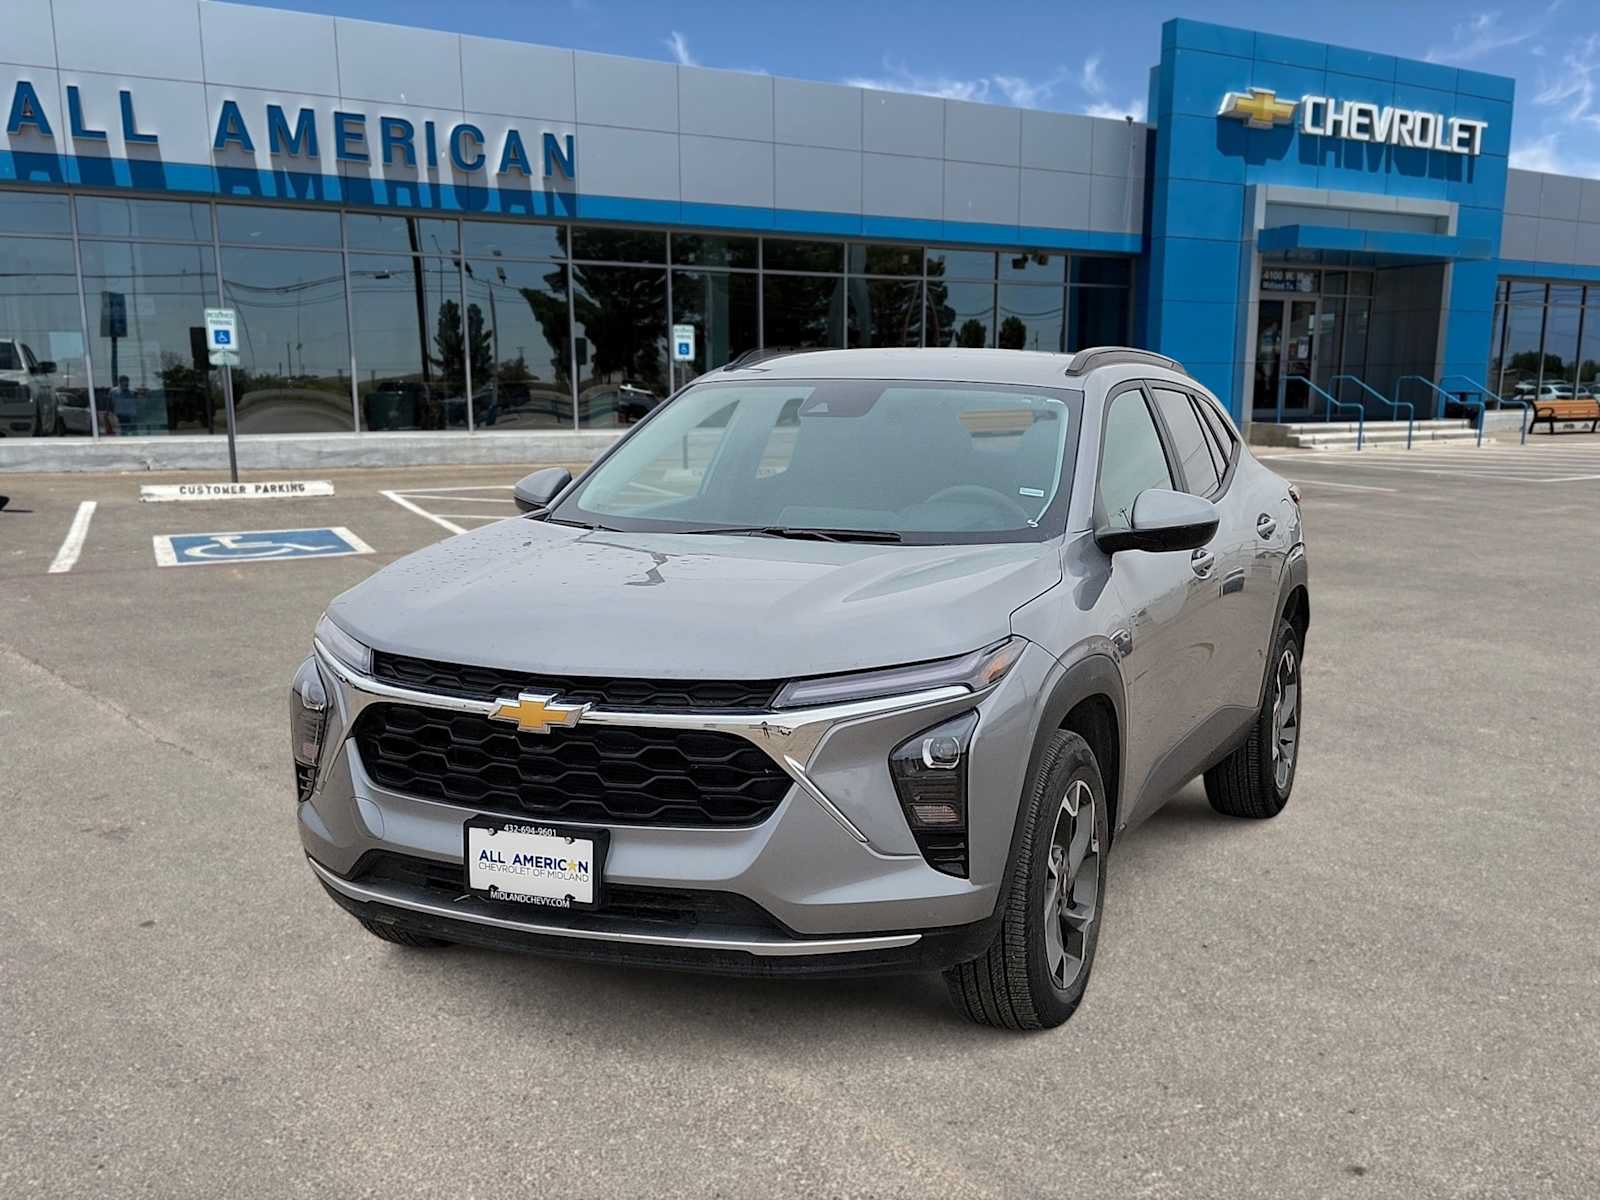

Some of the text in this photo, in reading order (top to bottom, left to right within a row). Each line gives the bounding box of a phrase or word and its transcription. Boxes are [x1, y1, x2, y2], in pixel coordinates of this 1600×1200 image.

[6, 81, 576, 178] ALL AMERICAN
[1301, 94, 1488, 155] CHEVROLET
[179, 483, 306, 495] CUSTOMER PARKING
[503, 823, 557, 838] 432-694-9601
[479, 849, 506, 864] ALL
[478, 861, 589, 883] CHEVROLET OF MIDLAND
[490, 889, 570, 908] MIDLANDCHEVY.COM
